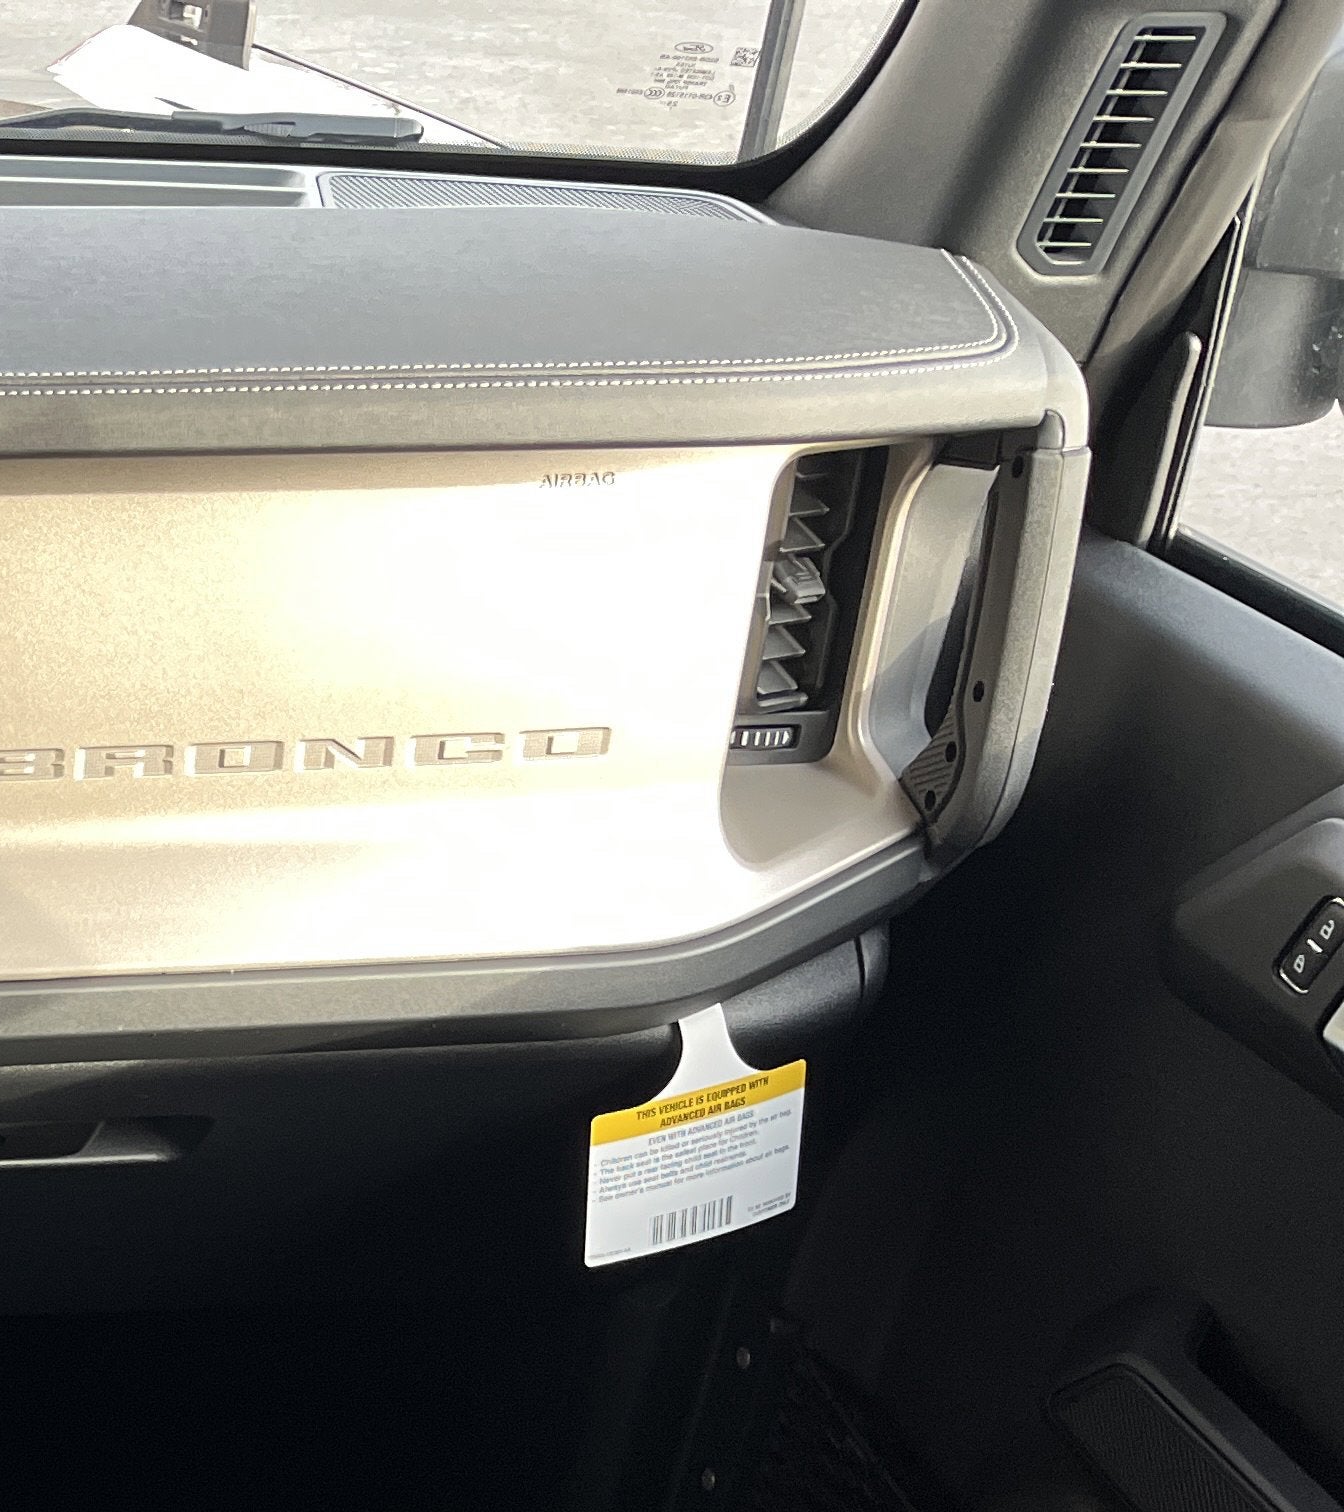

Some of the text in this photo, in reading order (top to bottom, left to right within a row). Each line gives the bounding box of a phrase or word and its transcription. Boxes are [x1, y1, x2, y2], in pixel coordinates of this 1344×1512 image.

[539, 471, 615, 488] AIRBAG
[636, 1077, 769, 1120] THIS VEHICLE IS EQUIPPED WITH
[660, 1098, 746, 1128] ADVANCED AIR BAGS
